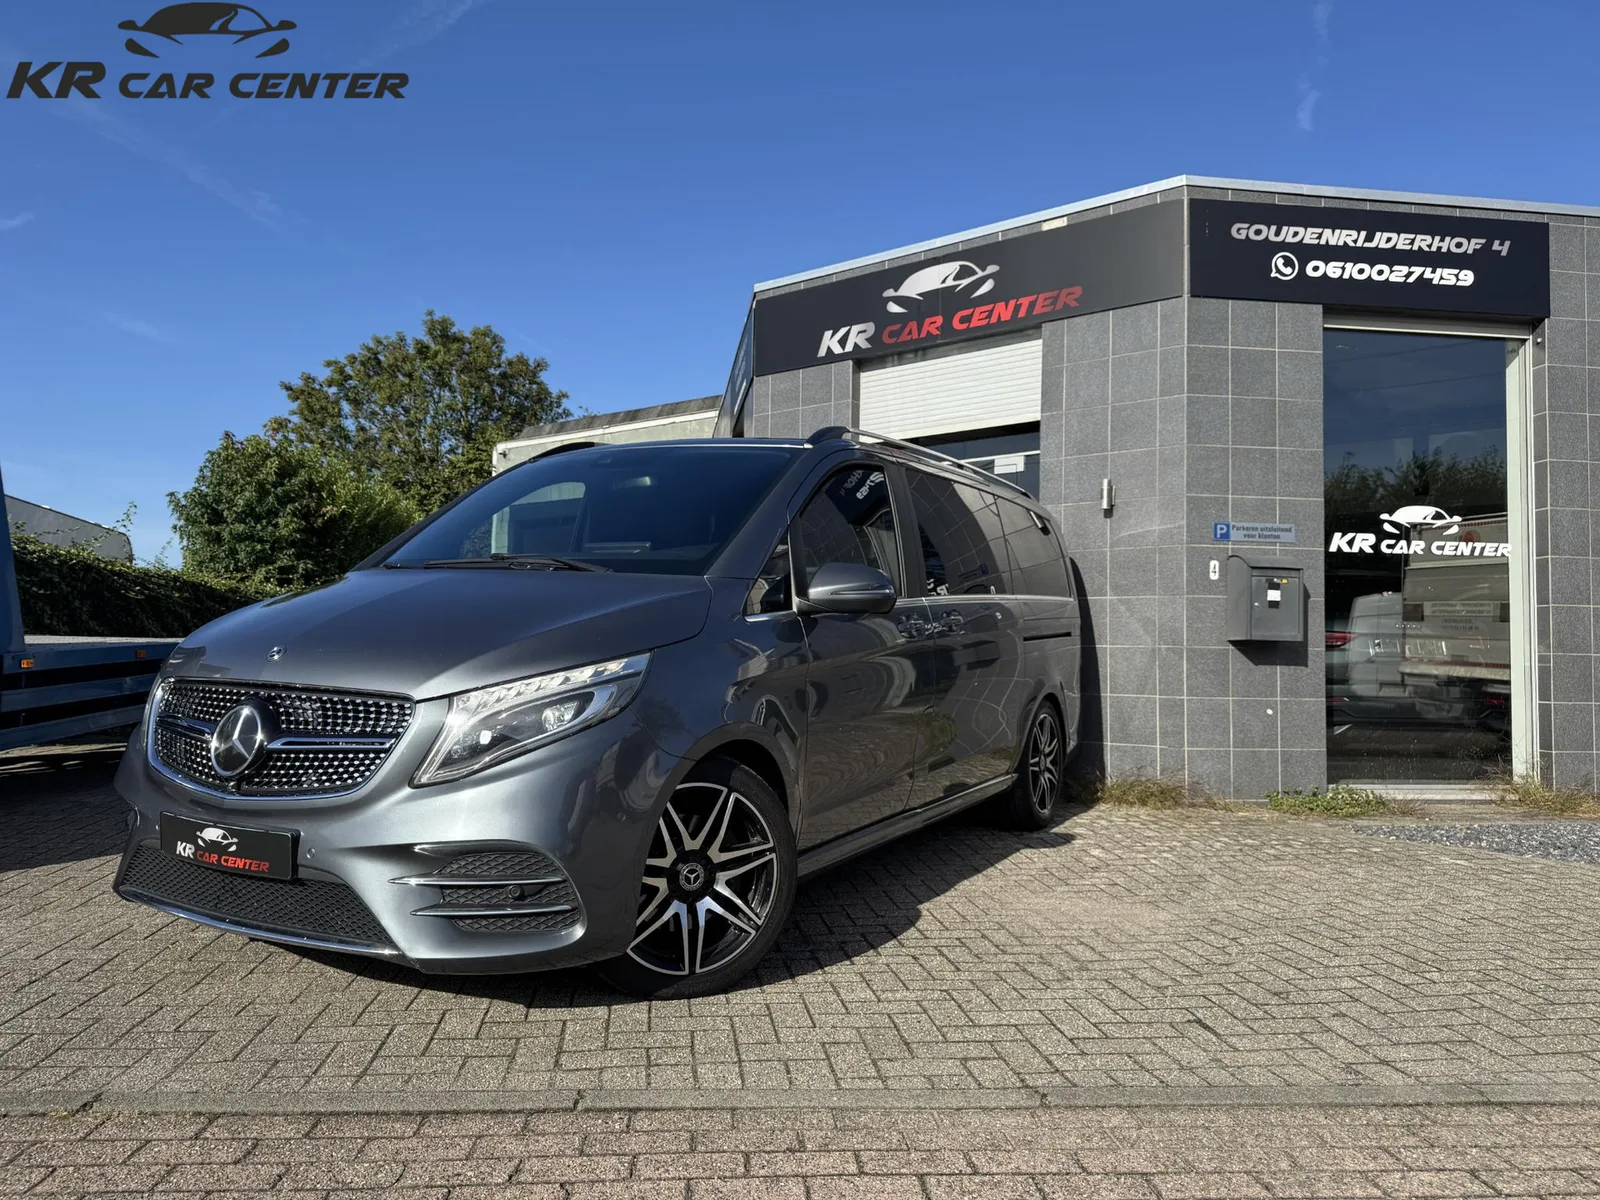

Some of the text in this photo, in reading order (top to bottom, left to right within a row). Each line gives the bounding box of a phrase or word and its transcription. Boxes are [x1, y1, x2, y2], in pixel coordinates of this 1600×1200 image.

[1230, 222, 1511, 257] GOUDENRIJDERHOF 4
[1305, 259, 1475, 287] 0610027459
[817, 285, 1083, 358] KR CAR CENTER
[1216, 524, 1227, 539] P
[1328, 532, 1512, 557] KR CAR CENTER
[175, 840, 270, 873] KR CAR CENTER
